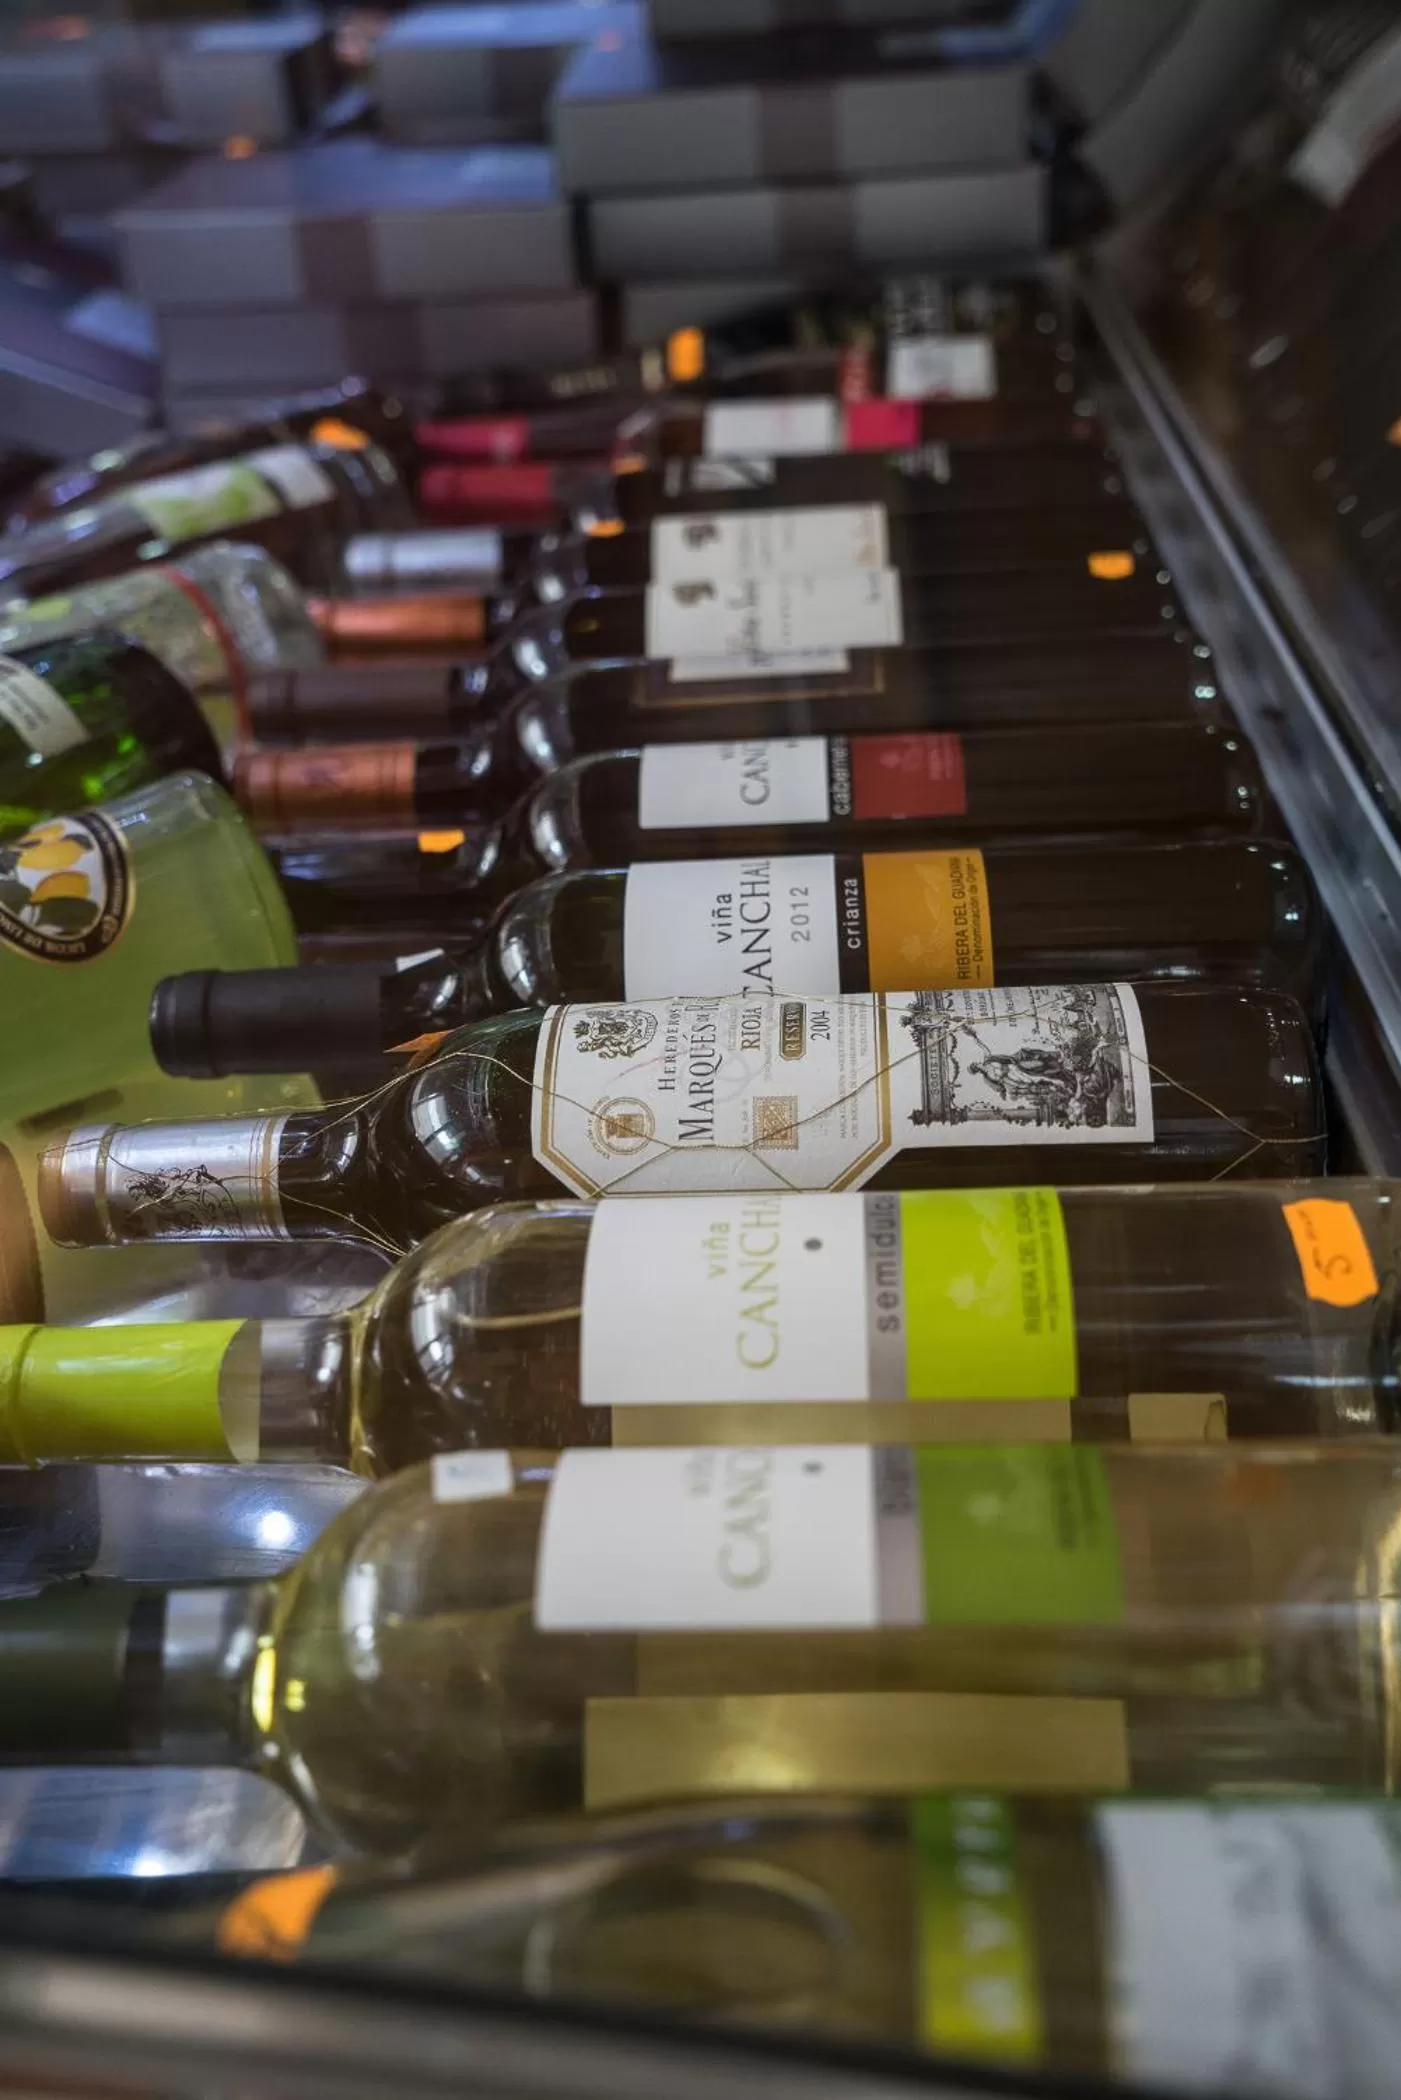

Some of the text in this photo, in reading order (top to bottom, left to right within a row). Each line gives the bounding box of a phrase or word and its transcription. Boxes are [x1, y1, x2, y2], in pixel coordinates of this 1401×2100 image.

[712, 893, 733, 944] viña
[790, 886, 811, 943] 2012
[843, 879, 861, 949] crianza
[953, 901, 968, 926] DEL
[955, 929, 971, 980] RIBERA
[658, 1009, 682, 1090] HEREDEROS
[741, 1006, 762, 1051] RIOJA
[783, 1006, 801, 1051] RESERV
[810, 1010, 831, 1041] 2004
[678, 1022, 722, 1141] MARQUÉS
[702, 1222, 730, 1279] viña
[736, 1193, 781, 1370] CANCHA
